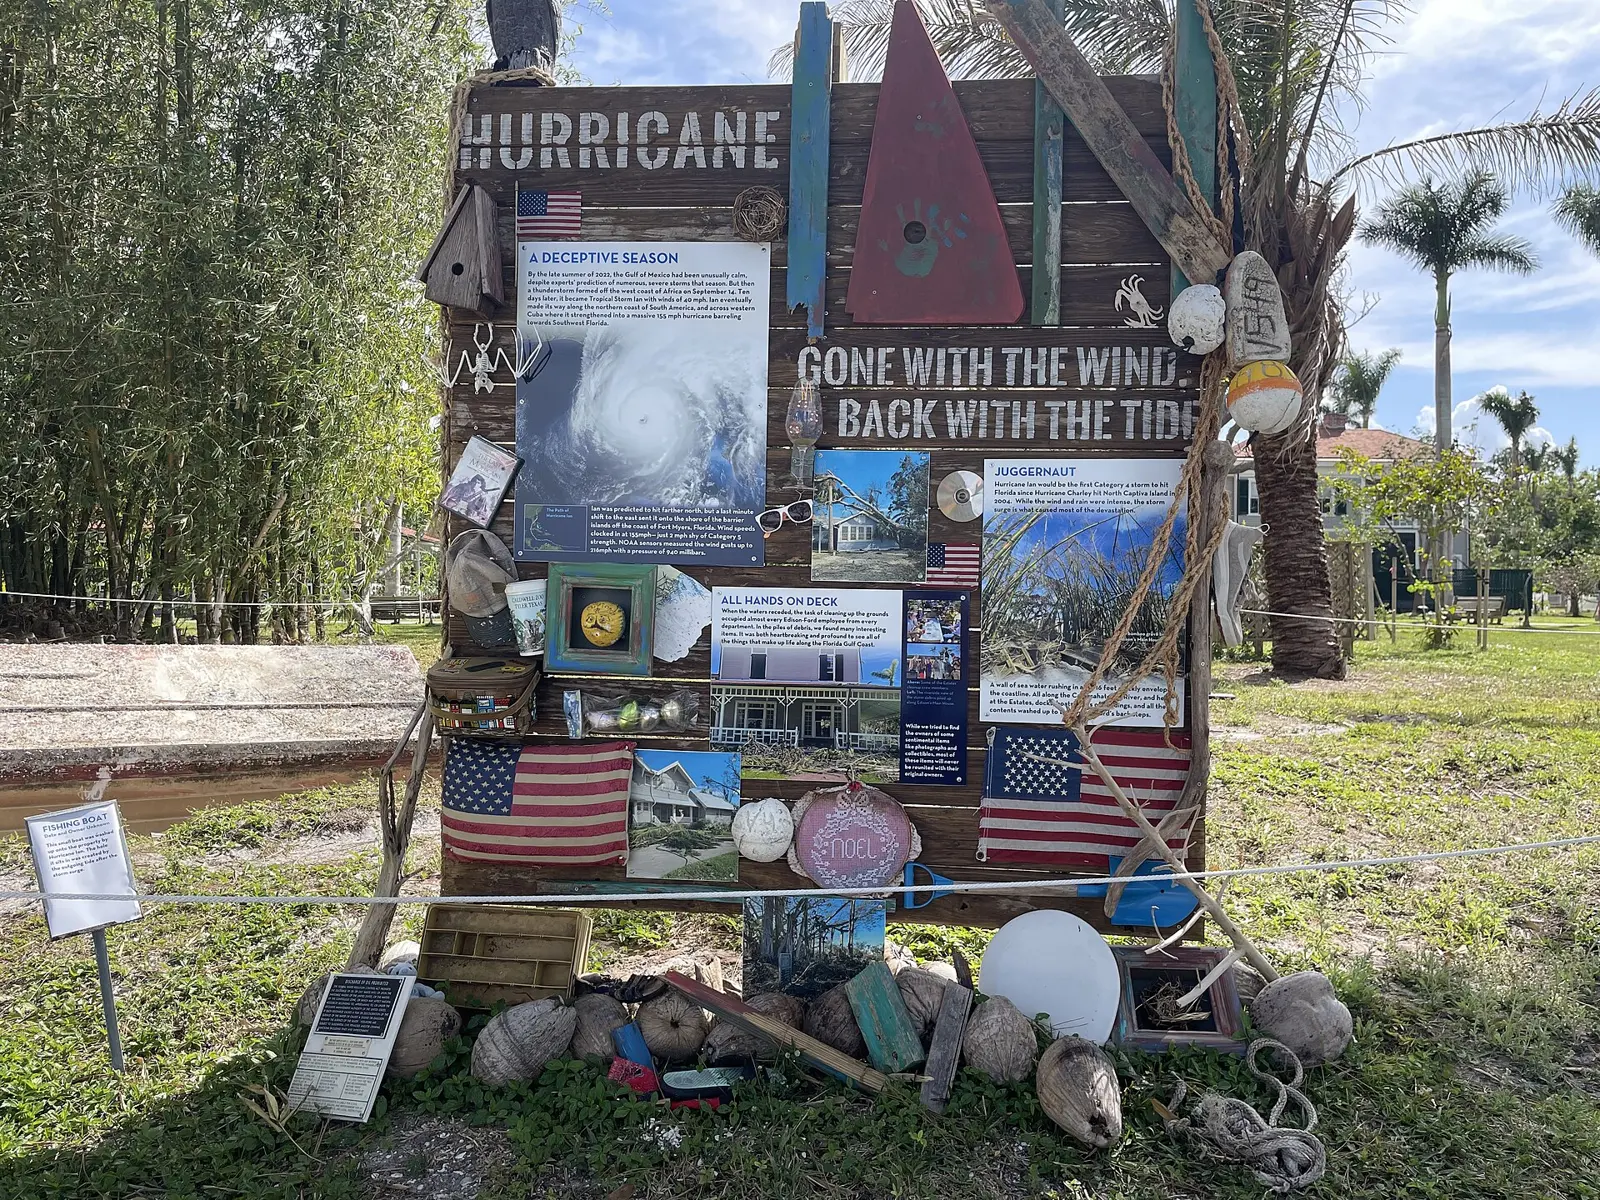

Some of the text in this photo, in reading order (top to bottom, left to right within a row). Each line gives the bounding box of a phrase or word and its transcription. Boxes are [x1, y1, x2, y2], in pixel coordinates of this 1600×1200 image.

[460, 111, 780, 170] HURRICANE
[529, 252, 678, 264] A DECEPTIVE SEASON
[701, 272, 730, 280] unusually
[731, 272, 748, 280] calm,
[528, 279, 550, 287] despite
[576, 279, 607, 287] prediction
[571, 312, 612, 320] strengthened
[668, 312, 682, 320] mph
[714, 313, 741, 321] barreling
[797, 346, 1187, 388] GONE WITH THE WIND.
[838, 398, 937, 439] BACK
[944, 398, 1036, 440] WITH
[1044, 399, 1114, 440] THE
[994, 467, 1076, 477] JUGGERNAUT
[1094, 481, 1124, 489] Category
[1067, 490, 1092, 498] Charley
[1123, 490, 1148, 498] Captiva
[614, 506, 643, 514] predicted
[685, 507, 703, 515] north,
[721, 596, 838, 607] ALL HANDS ON DECK
[768, 608, 793, 616] receded,
[824, 609, 847, 618] cleaning
[866, 610, 889, 618] grounds
[732, 638, 748, 646] things
[796, 639, 811, 648] along
[1048, 684, 1071, 692] rushing
[42, 813, 108, 832] FISHING BOAT
[830, 838, 877, 859] NOEL
